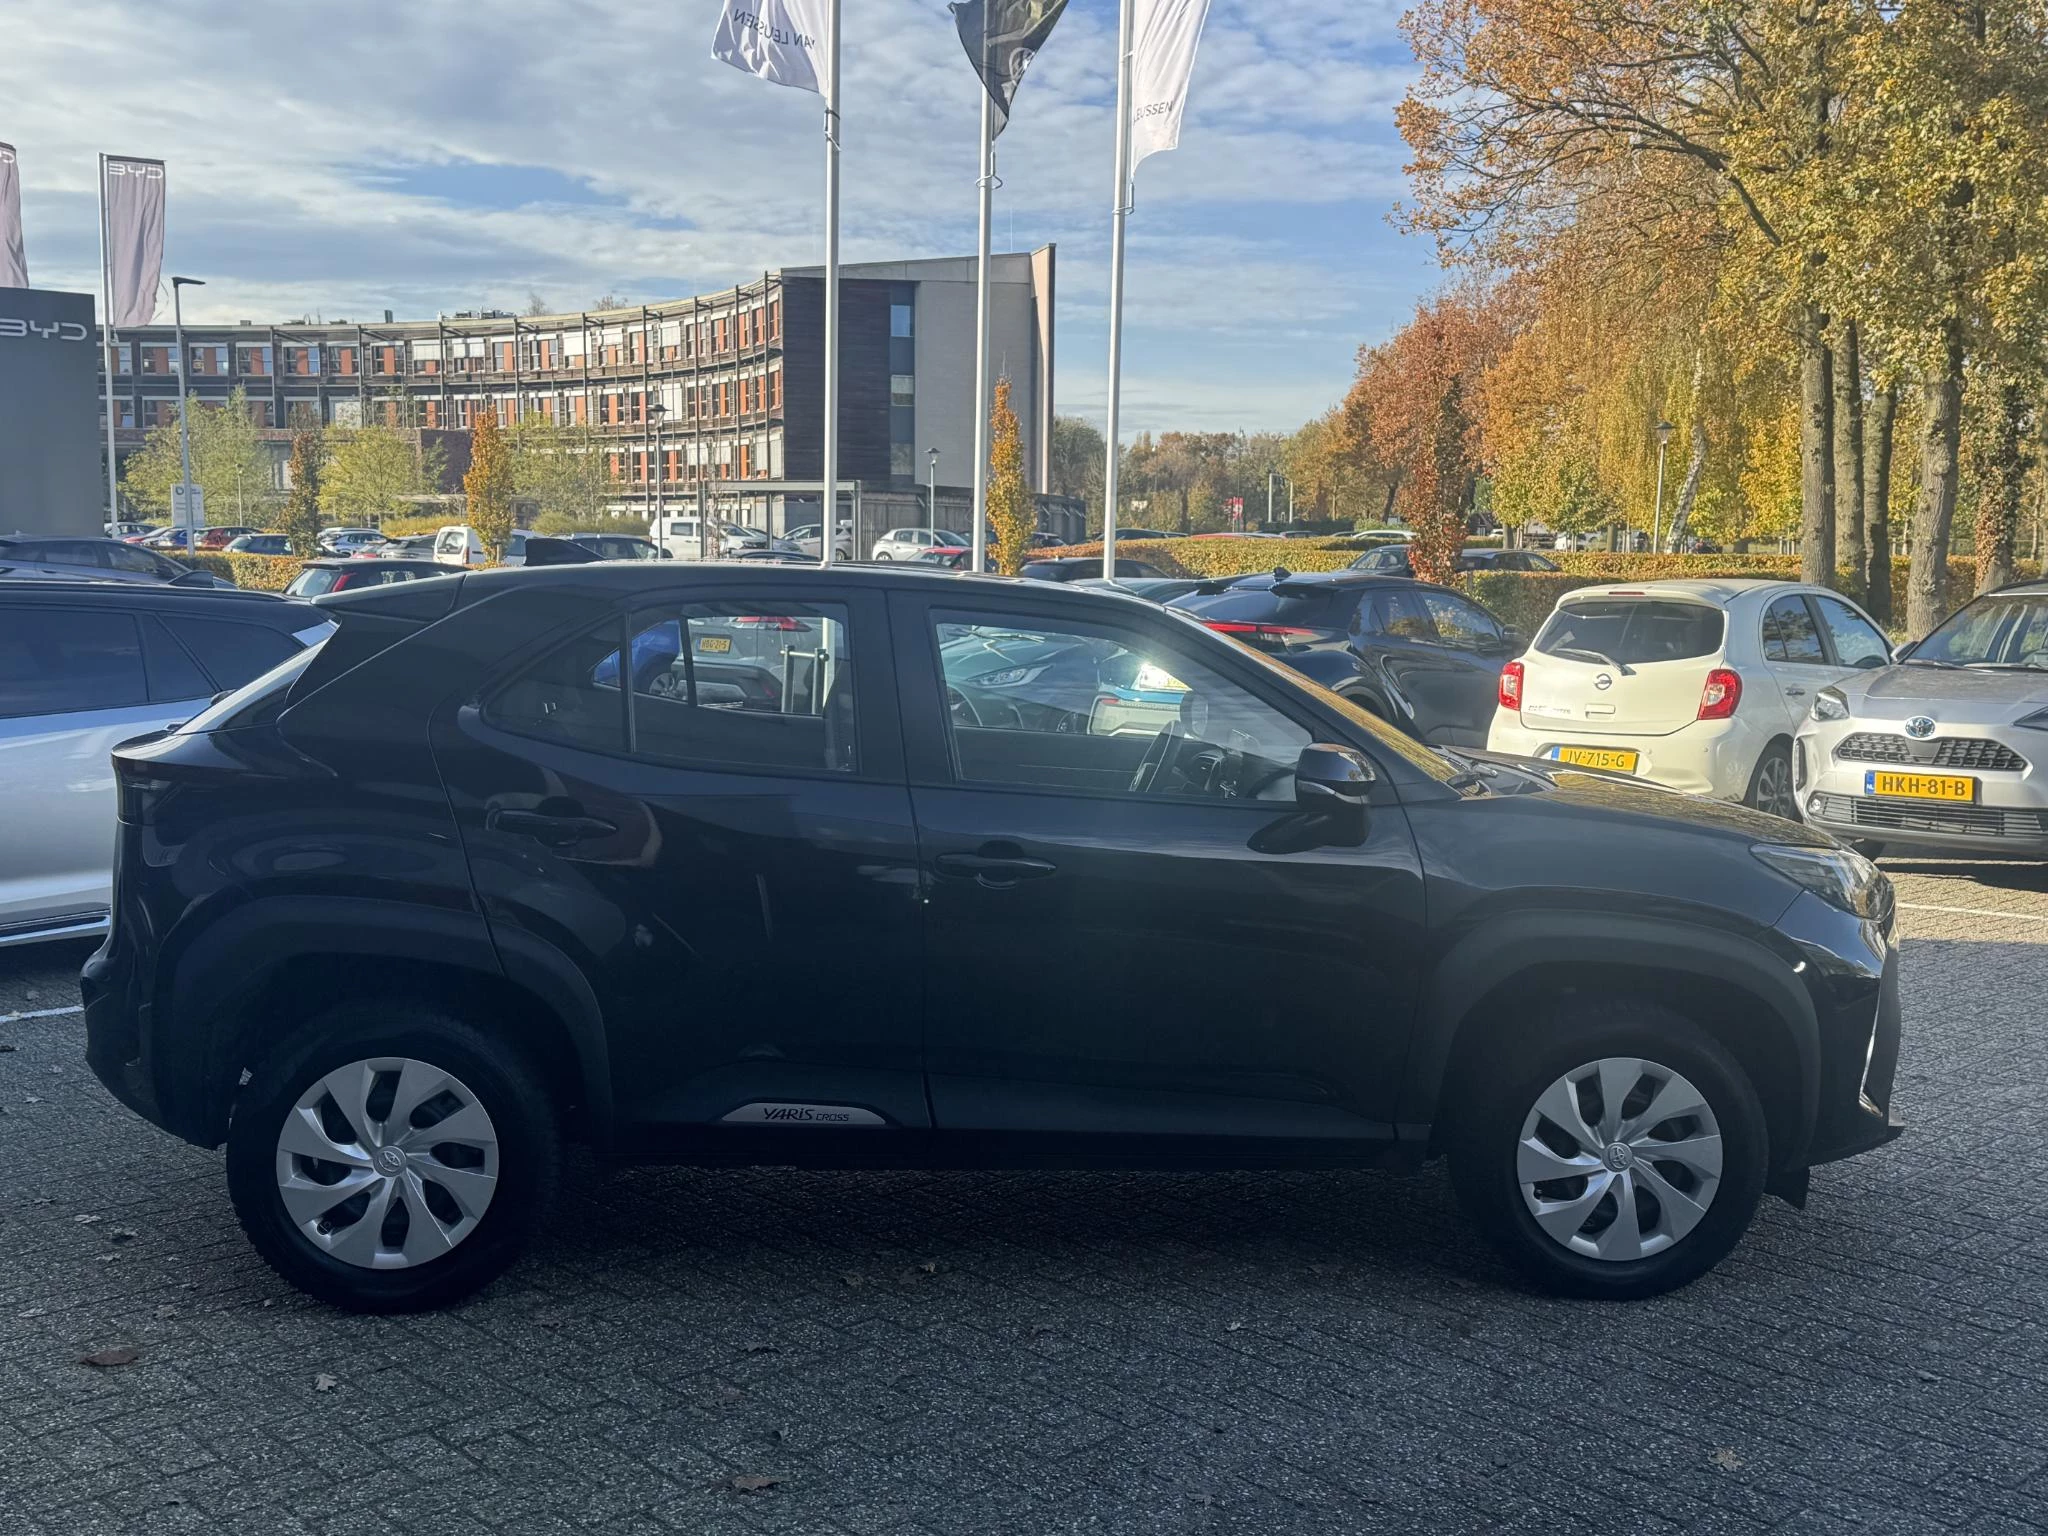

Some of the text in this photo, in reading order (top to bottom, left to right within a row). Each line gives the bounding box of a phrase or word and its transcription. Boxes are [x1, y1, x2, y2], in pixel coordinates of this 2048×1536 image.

[108, 163, 164, 179] BYD
[0, 317, 88, 341] BYD
[1882, 775, 1966, 796] HKH-81-B
[815, 1113, 850, 1122] CROSS
